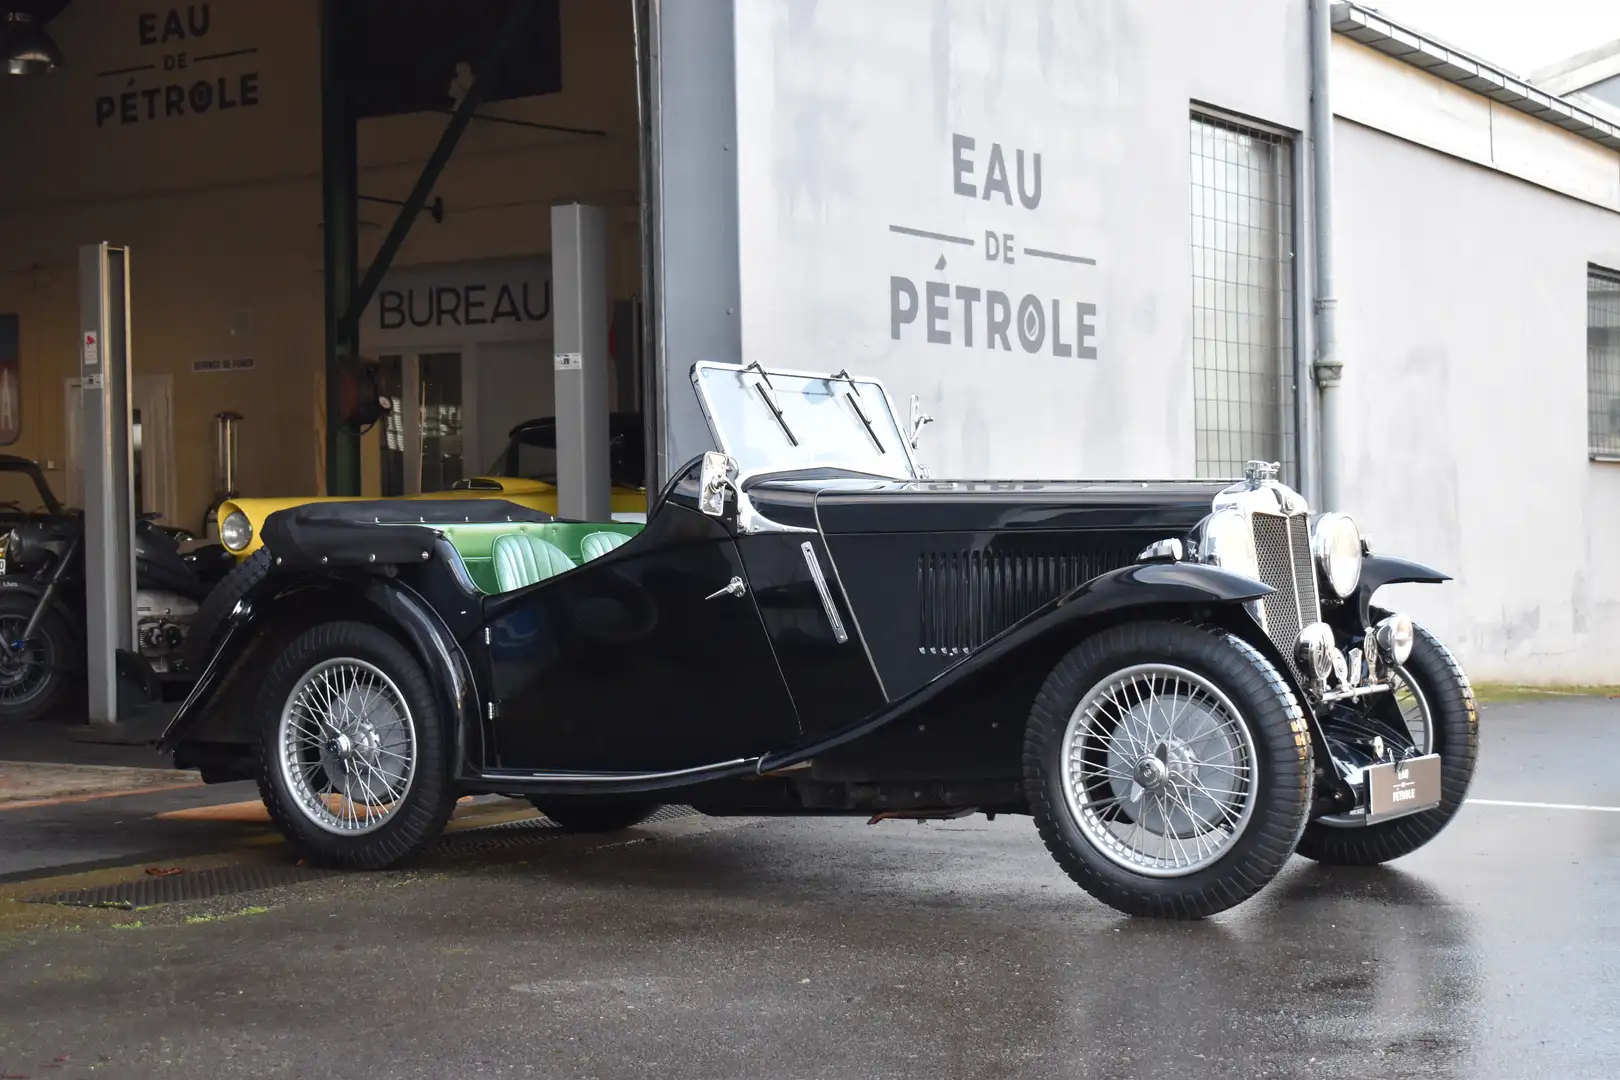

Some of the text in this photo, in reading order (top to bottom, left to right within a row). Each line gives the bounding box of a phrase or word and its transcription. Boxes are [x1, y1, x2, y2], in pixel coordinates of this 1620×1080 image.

[138, 3, 210, 45] EAU
[163, 52, 188, 71] DE
[95, 73, 259, 128] PÉTROLE
[952, 133, 1042, 210] EAU
[985, 230, 1015, 264] DE
[379, 281, 549, 329] BUREAU
[890, 253, 1097, 360] PÉTROLE
